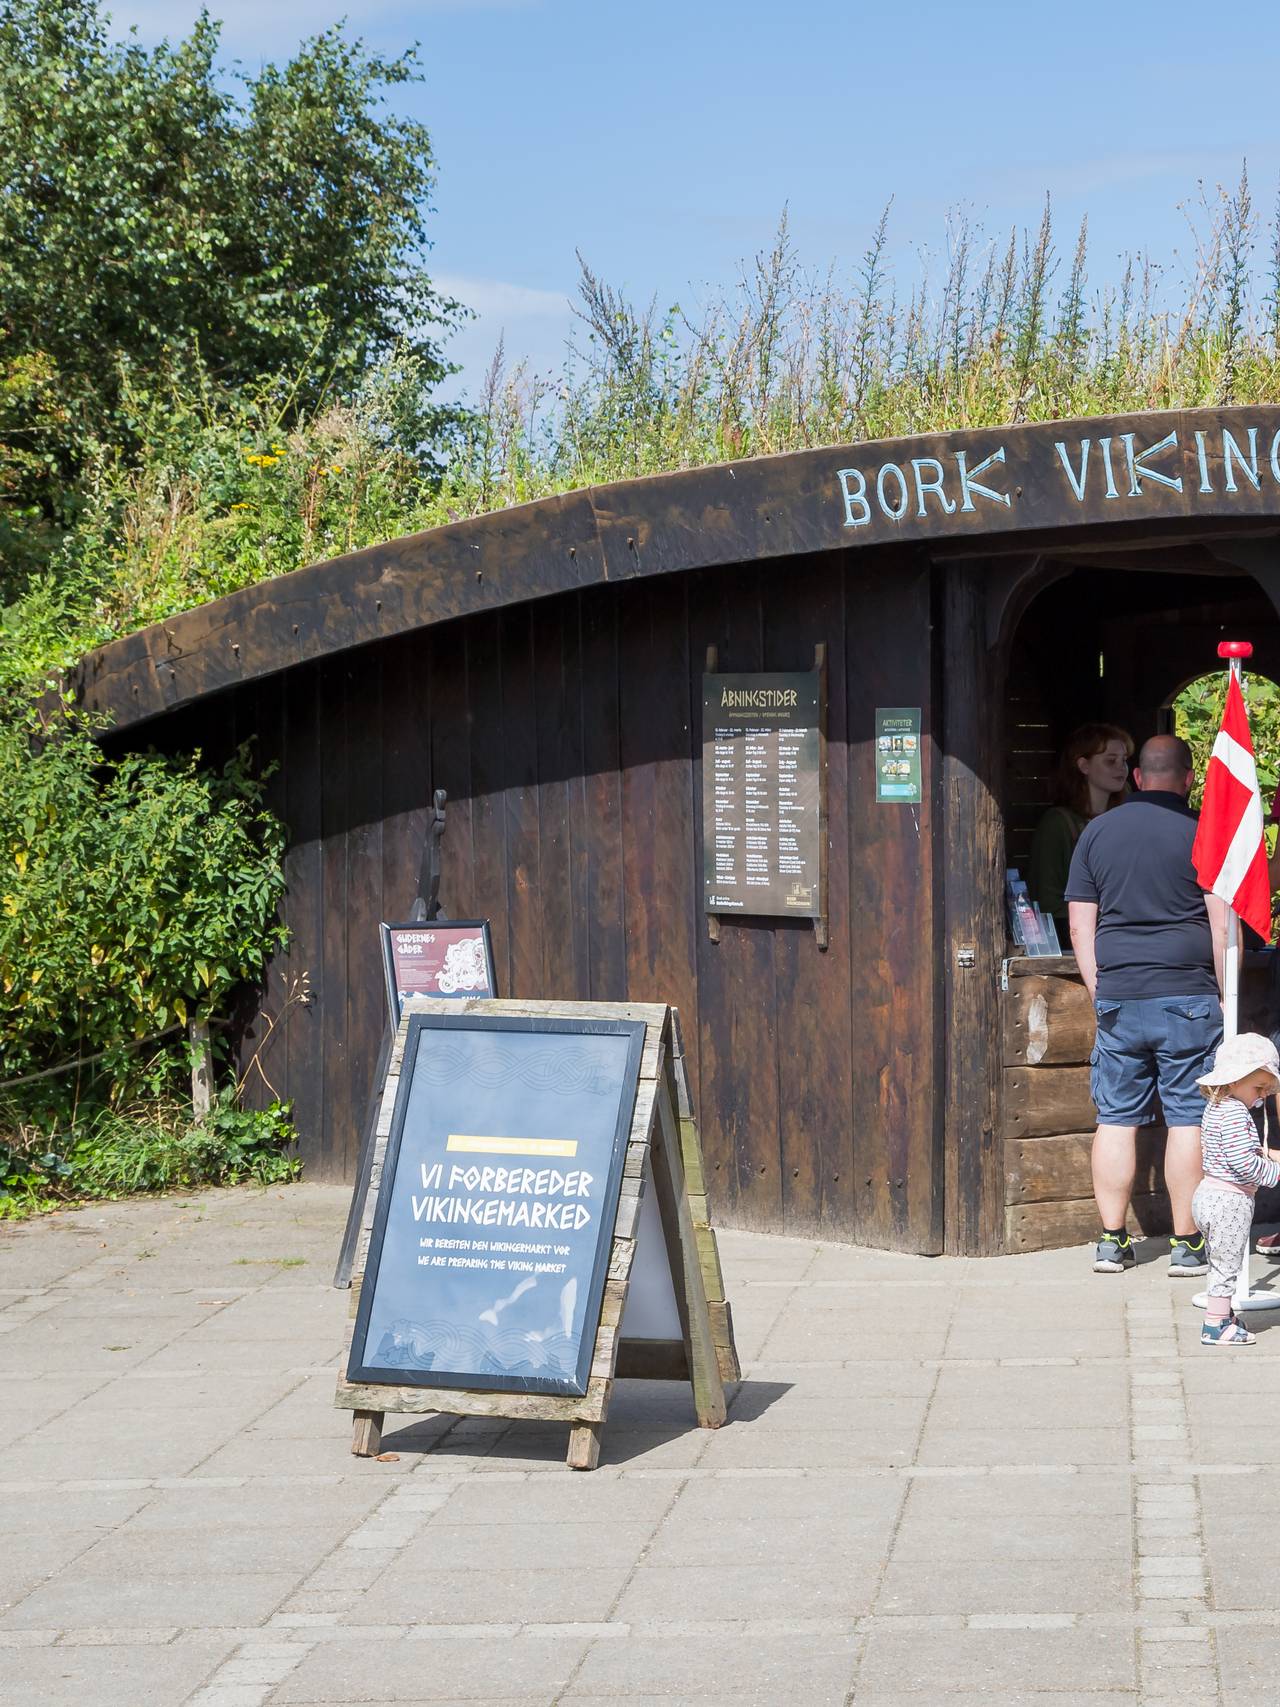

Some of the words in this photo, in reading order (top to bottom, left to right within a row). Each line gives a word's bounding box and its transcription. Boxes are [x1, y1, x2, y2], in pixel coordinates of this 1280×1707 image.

[836, 446, 1012, 527] BORK
[721, 687, 797, 707] ÅBNINGSTIDER
[420, 1163, 444, 1190] VI
[448, 1165, 594, 1198] FORBEREDER
[411, 1195, 592, 1230] VIKINGEMARKED
[419, 1237, 434, 1249] WIR
[434, 1238, 471, 1250] BEREITEN
[472, 1240, 489, 1251] DEN
[490, 1241, 552, 1254] WIKINGERMARKT
[553, 1245, 570, 1256] VOR
[417, 1255, 431, 1265] WE
[431, 1256, 447, 1266] ARE
[447, 1257, 488, 1269] PREPARING
[490, 1259, 505, 1270] THE
[507, 1260, 534, 1272] VIKING
[534, 1261, 567, 1273] MARKET
